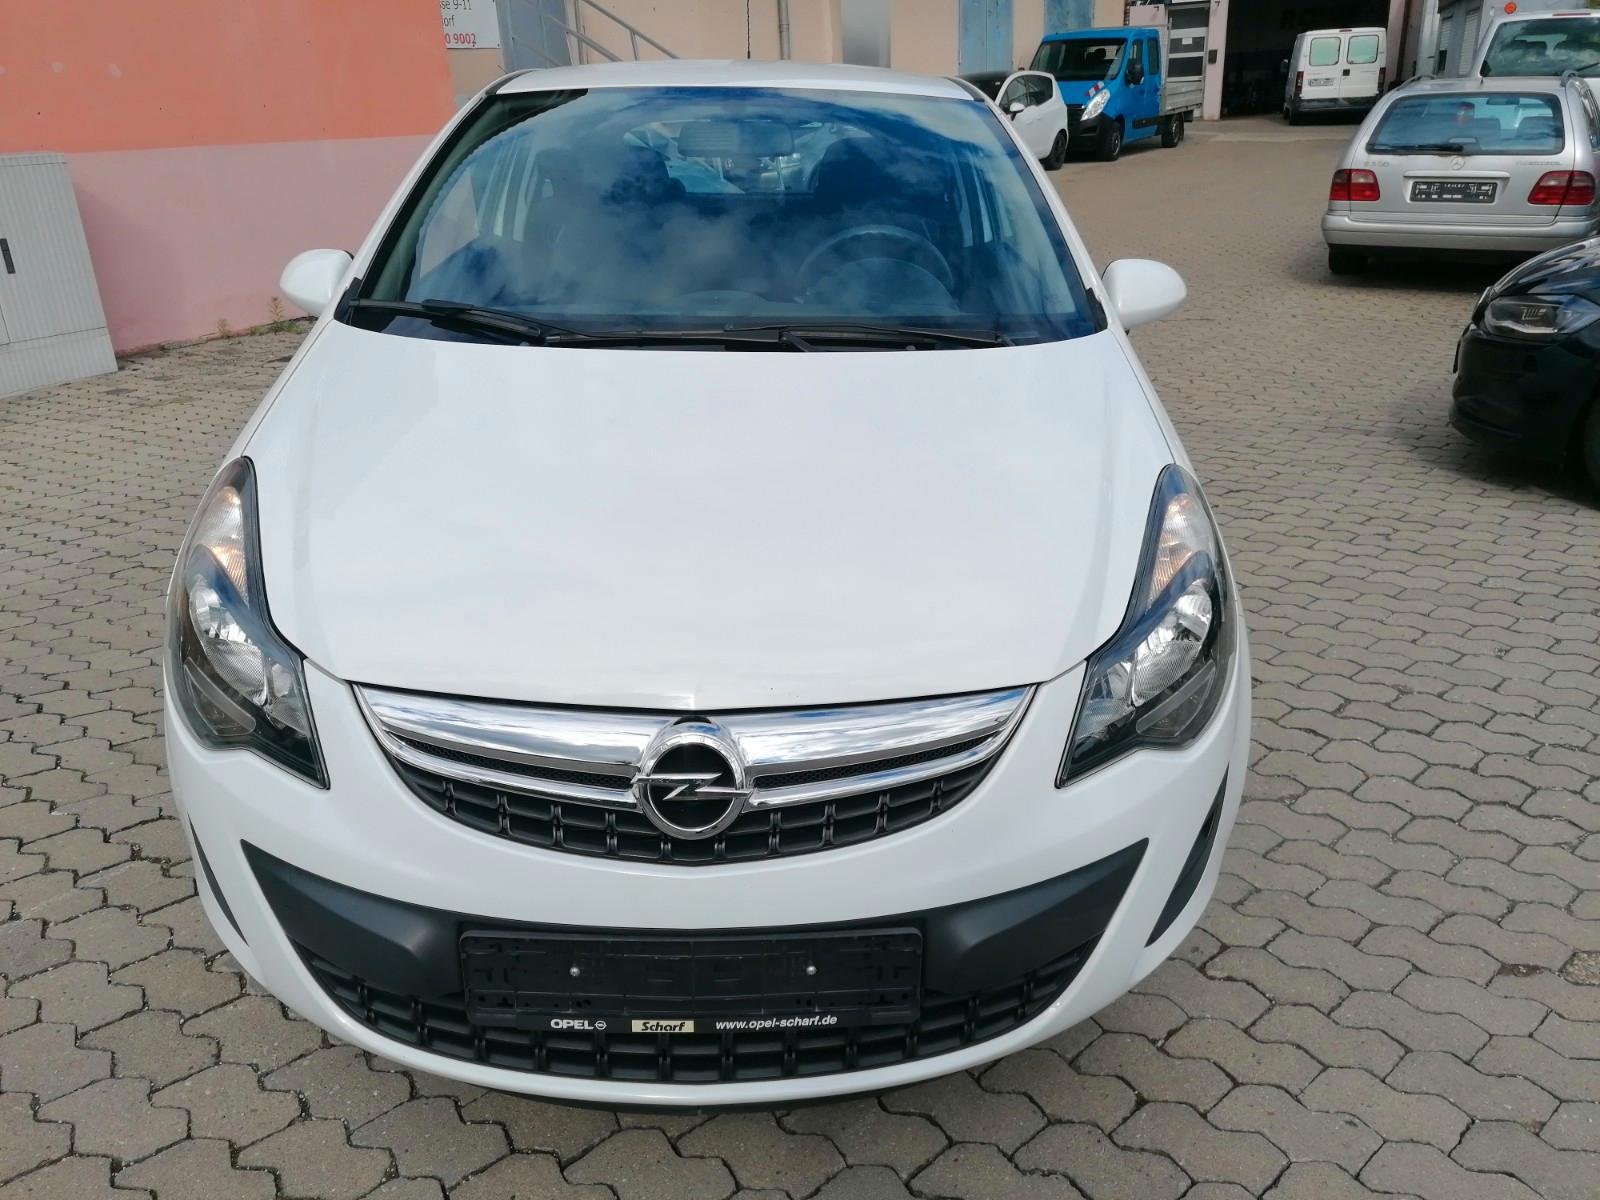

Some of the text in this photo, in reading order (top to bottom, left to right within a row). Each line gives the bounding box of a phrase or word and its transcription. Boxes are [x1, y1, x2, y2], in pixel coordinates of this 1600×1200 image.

[453, 0, 472, 10] 9-11
[453, 33, 477, 44] 9002
[550, 1015, 837, 1031] OPEL Scharf www.opel-scharf.de
